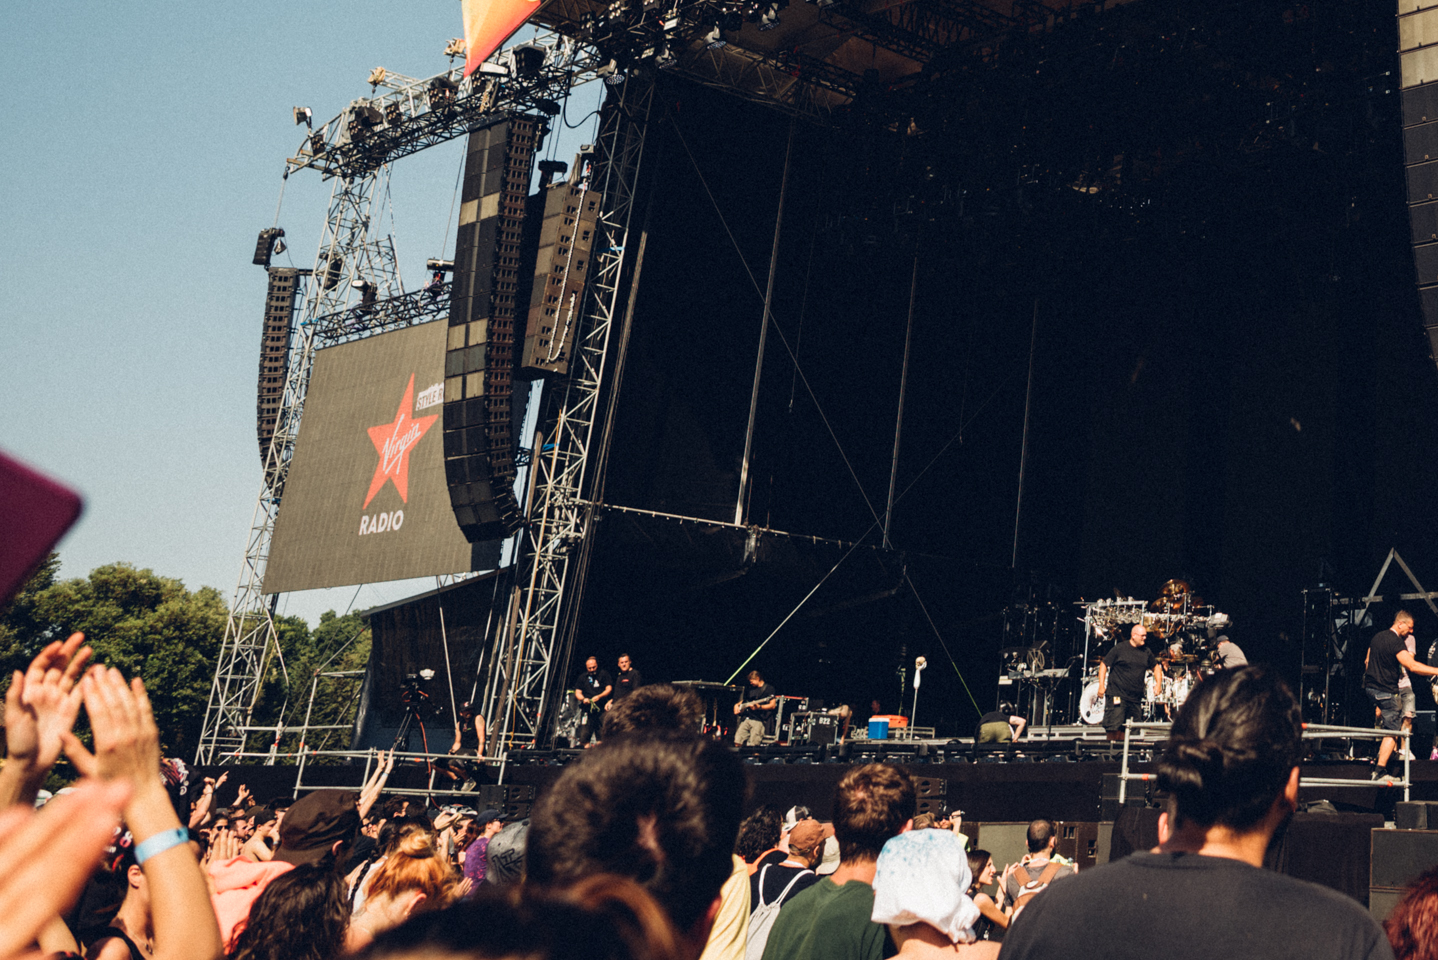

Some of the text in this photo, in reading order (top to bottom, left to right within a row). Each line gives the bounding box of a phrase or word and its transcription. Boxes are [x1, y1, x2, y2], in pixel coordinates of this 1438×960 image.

[417, 391, 437, 408] STYLE
[382, 413, 421, 475] Virgin
[358, 510, 404, 536] RADIO
